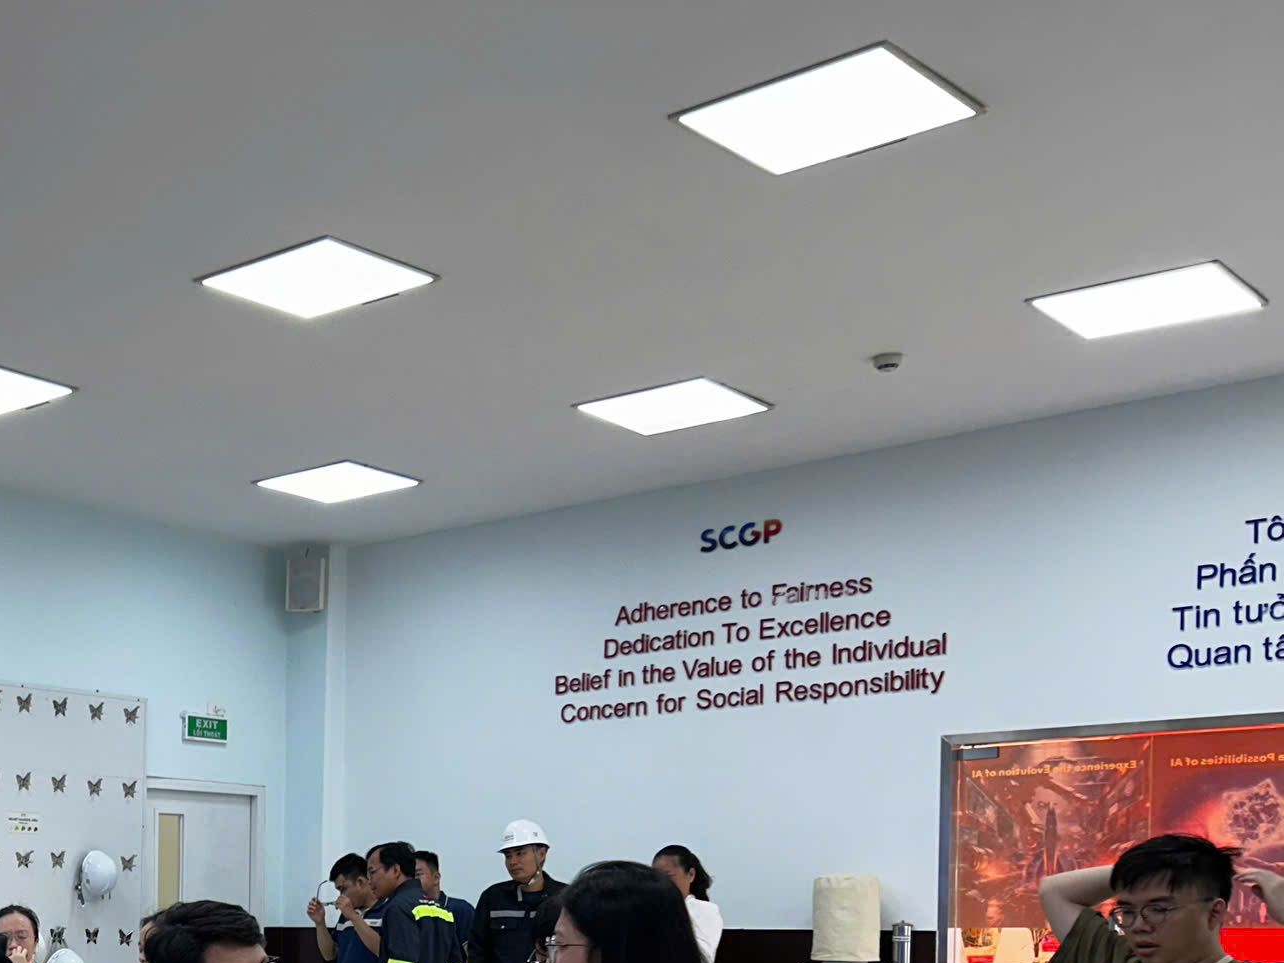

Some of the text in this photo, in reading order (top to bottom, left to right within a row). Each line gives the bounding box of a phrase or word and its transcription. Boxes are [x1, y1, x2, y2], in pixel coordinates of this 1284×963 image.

[700, 519, 783, 553] SCGP
[1196, 553, 1277, 590] Phấn
[614, 576, 873, 627] Adherence to Fairness
[1172, 605, 1220, 631] Tin
[604, 609, 891, 659] Dedication To Excellence
[555, 632, 947, 695] Belief in the Value of the Individual
[1167, 643, 1251, 669] Quan
[560, 667, 945, 724] Concern for Social Responsibility
[196, 718, 219, 730] EXIT
